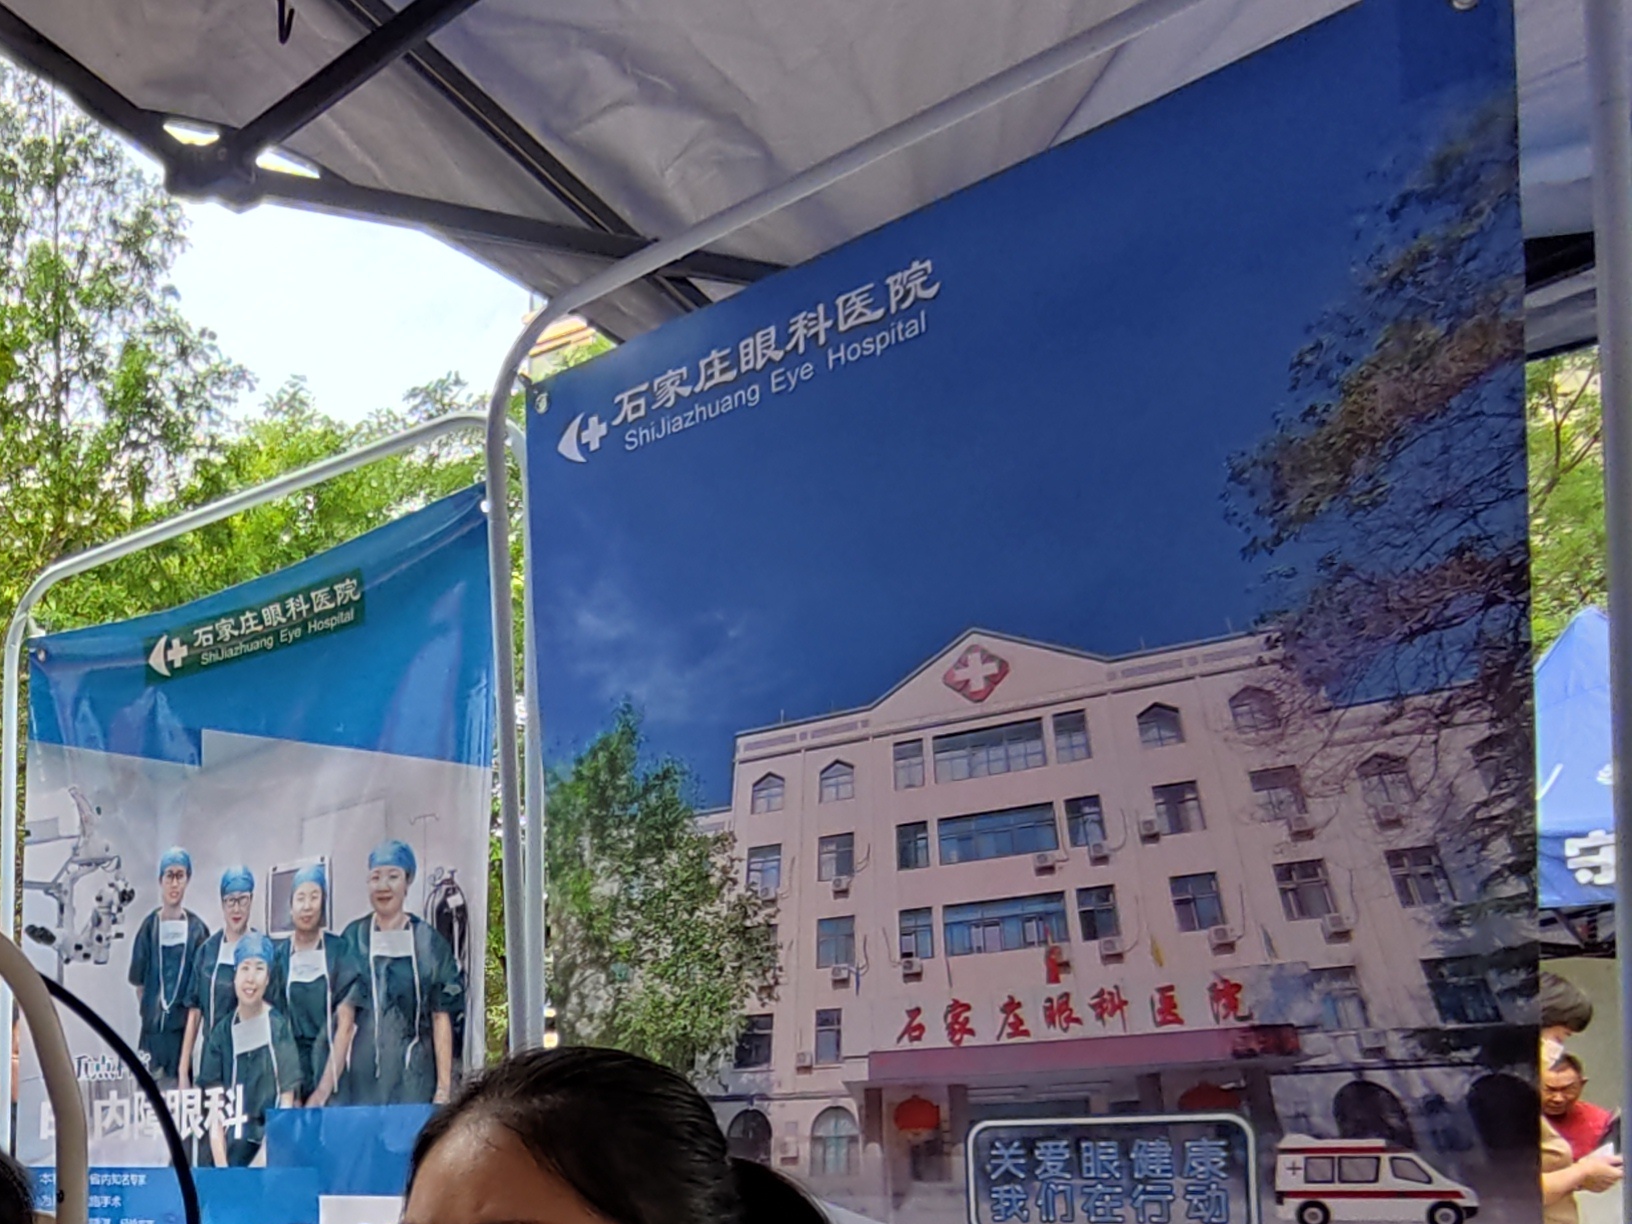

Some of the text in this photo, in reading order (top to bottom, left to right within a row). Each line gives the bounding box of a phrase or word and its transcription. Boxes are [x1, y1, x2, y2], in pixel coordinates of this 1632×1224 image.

[612, 258, 942, 427] 石家庄眼科医院
[624, 310, 927, 452] ShiJiazhuang Eye Hospital
[193, 577, 362, 647] 石家庄眼科医院
[201, 608, 355, 666] ShiJiazhuang Eye Hospital
[897, 975, 1255, 1047] 石家庄眼科医院
[989, 1137, 1229, 1181] 关爱眼健康
[989, 1183, 1231, 1224] 我们在行动
